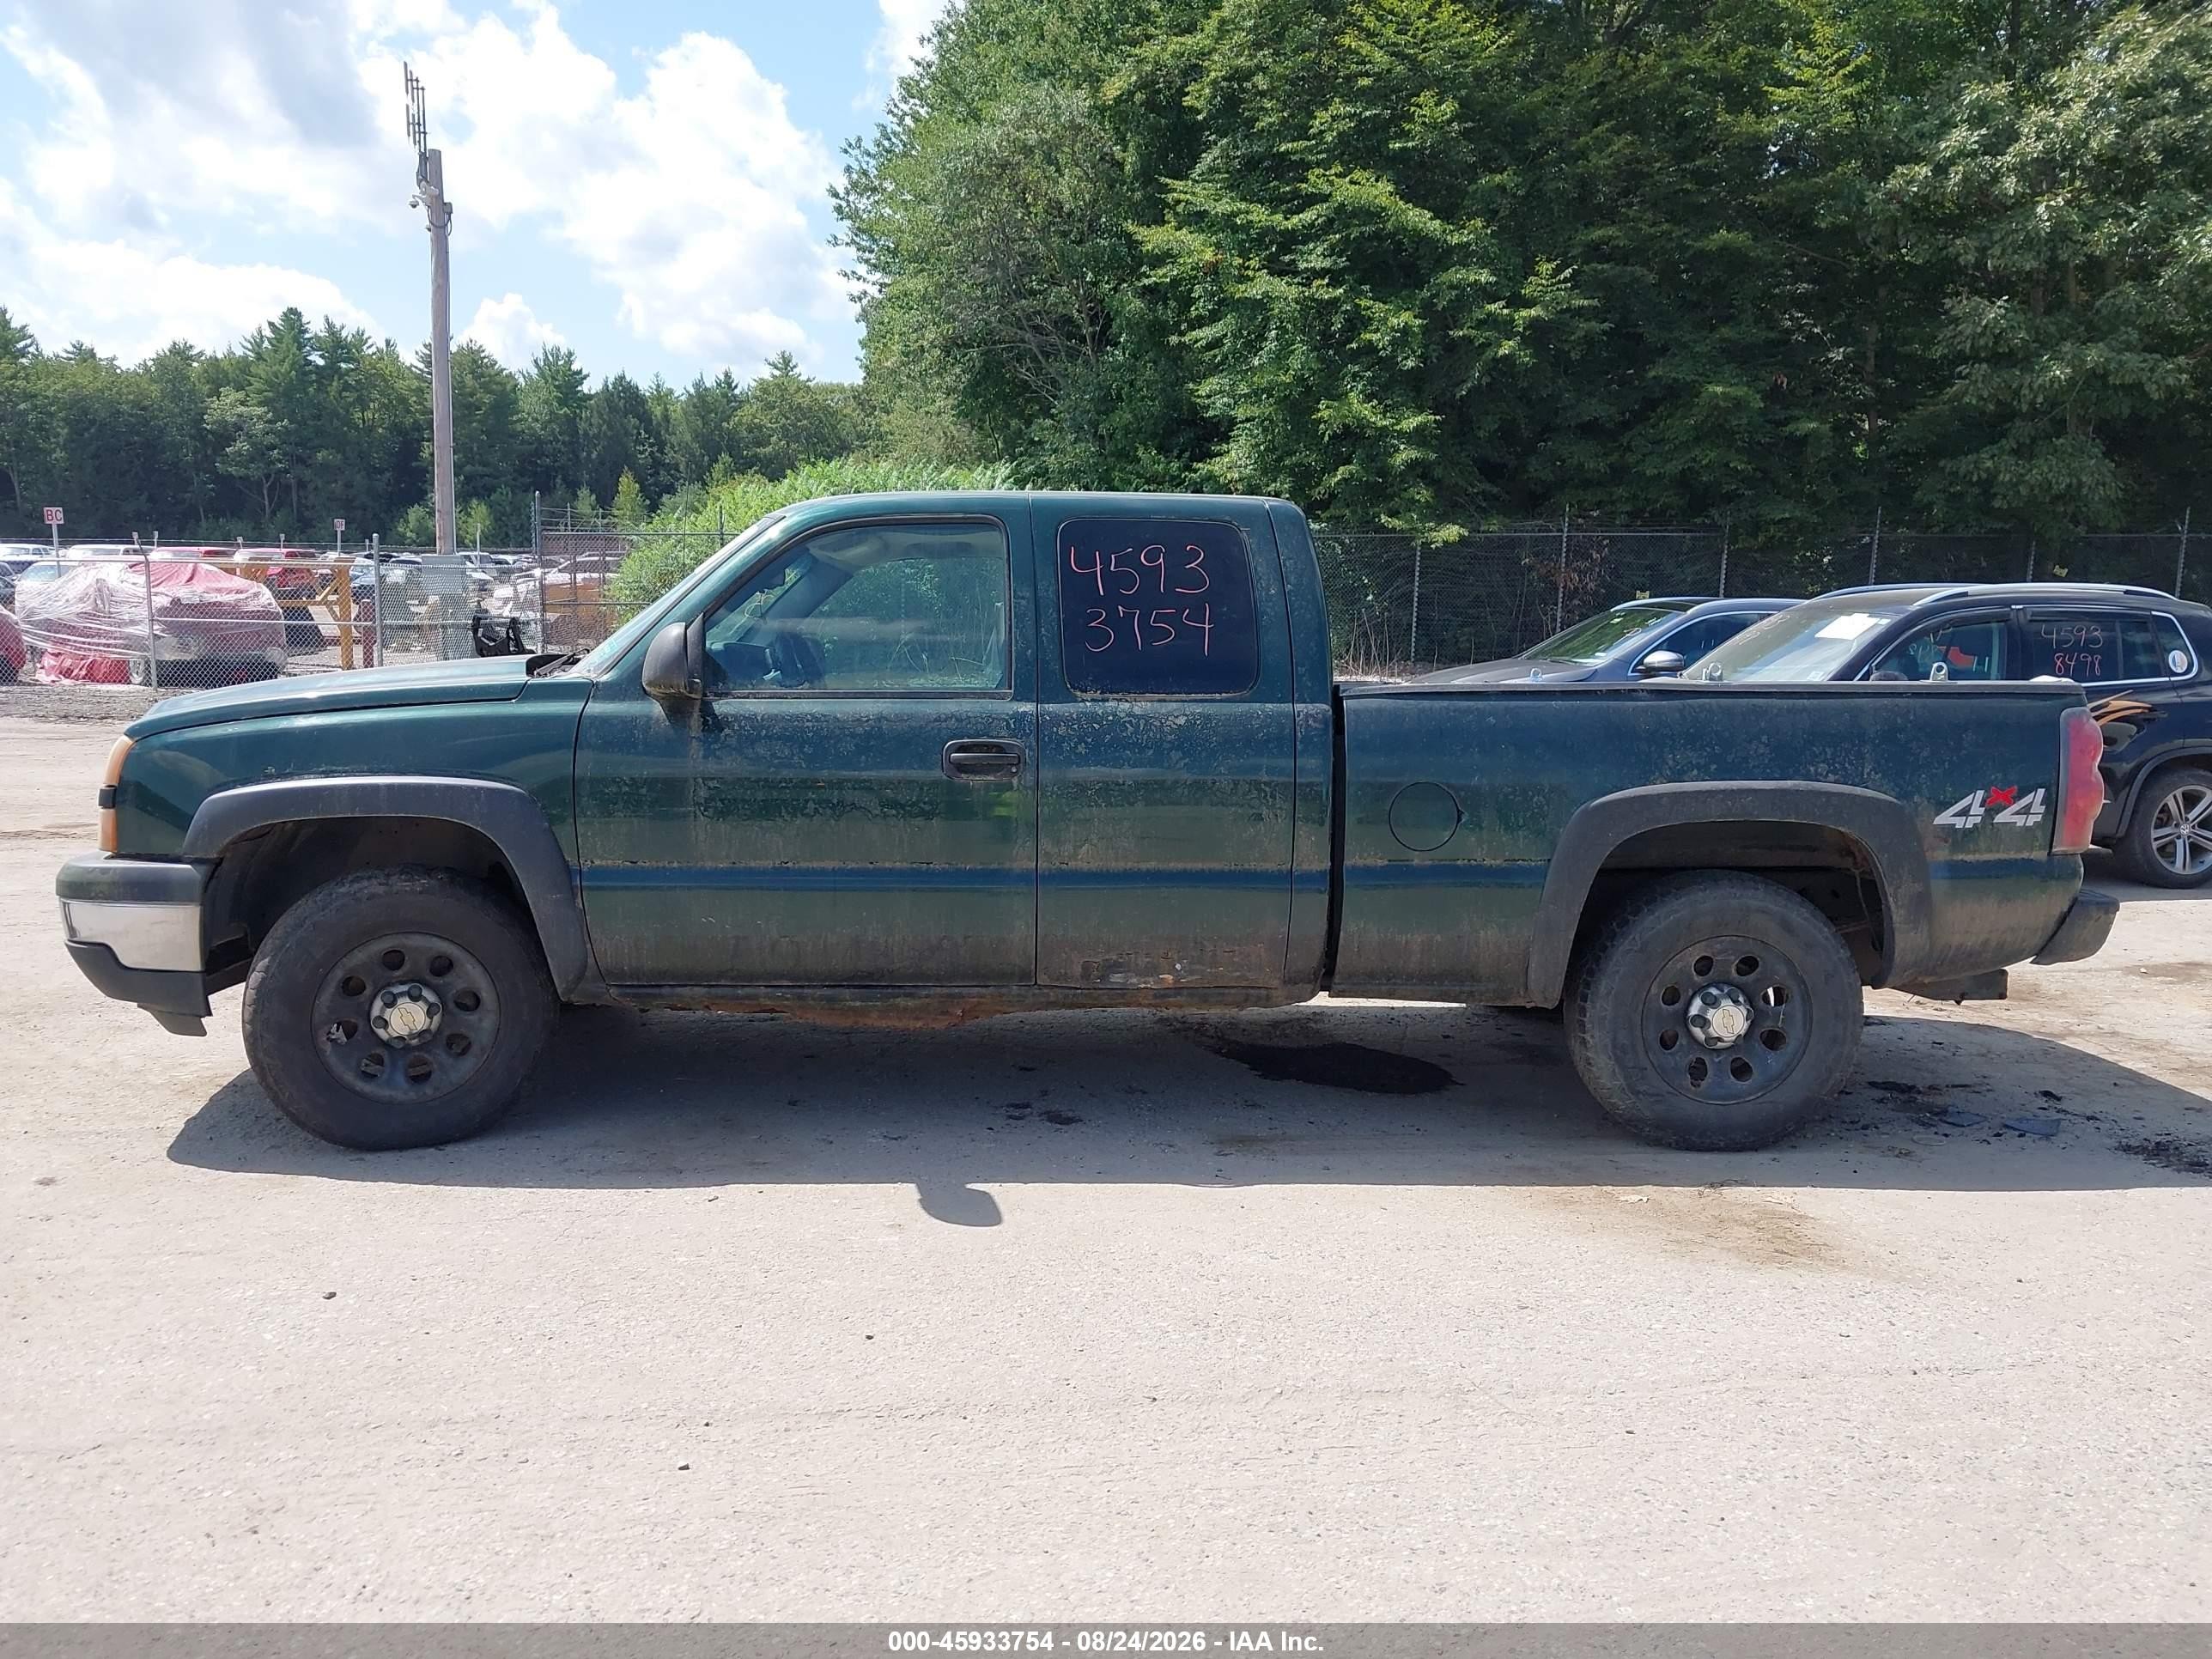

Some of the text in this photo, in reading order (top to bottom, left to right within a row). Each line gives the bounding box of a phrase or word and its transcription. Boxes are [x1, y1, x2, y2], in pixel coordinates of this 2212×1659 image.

[46, 508, 63, 521] BC
[1070, 544, 1210, 596] 4593
[1085, 603, 1214, 657] 3754
[2040, 623, 2103, 649] 4593
[2054, 652, 2103, 678] 8498
